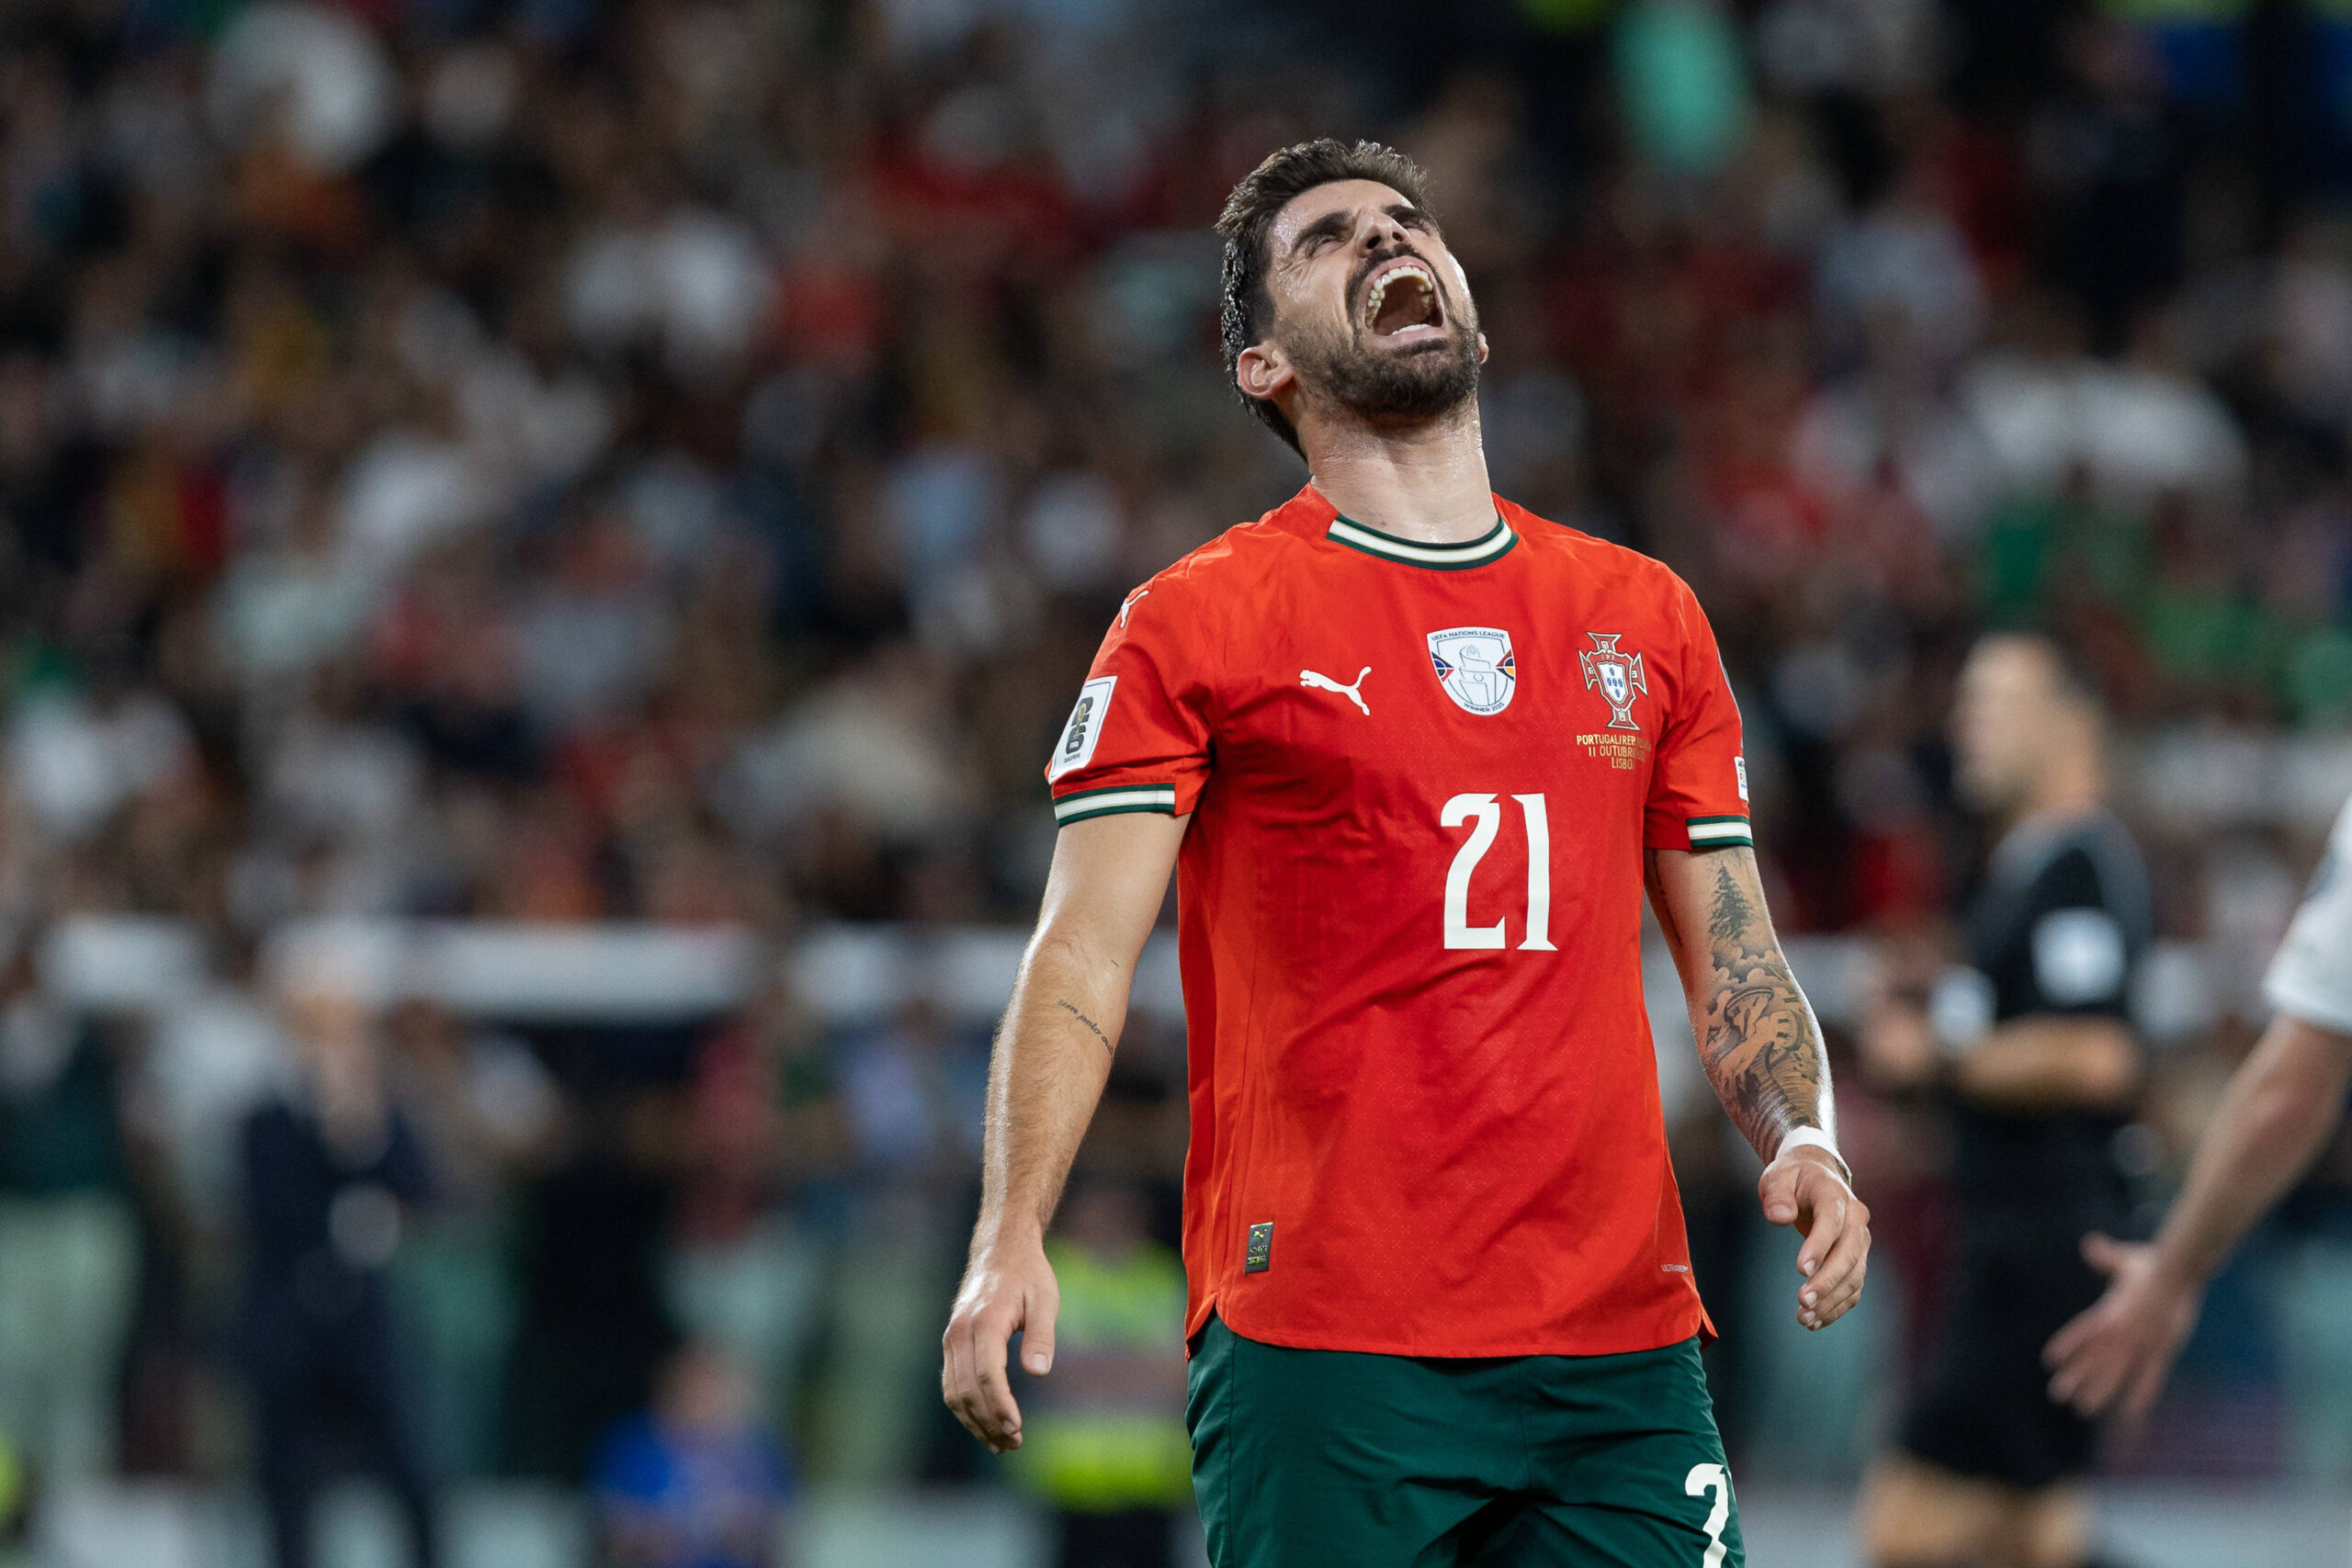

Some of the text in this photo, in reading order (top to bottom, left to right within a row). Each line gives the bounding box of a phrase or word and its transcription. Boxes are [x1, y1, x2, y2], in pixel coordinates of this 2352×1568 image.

[1430, 633, 1448, 641] UEFA
[1479, 630, 1505, 638] LEAGUE
[1611, 756, 1634, 770] LISBO
[1440, 792, 1559, 952] 21
[1684, 1462, 1736, 1568] 2
